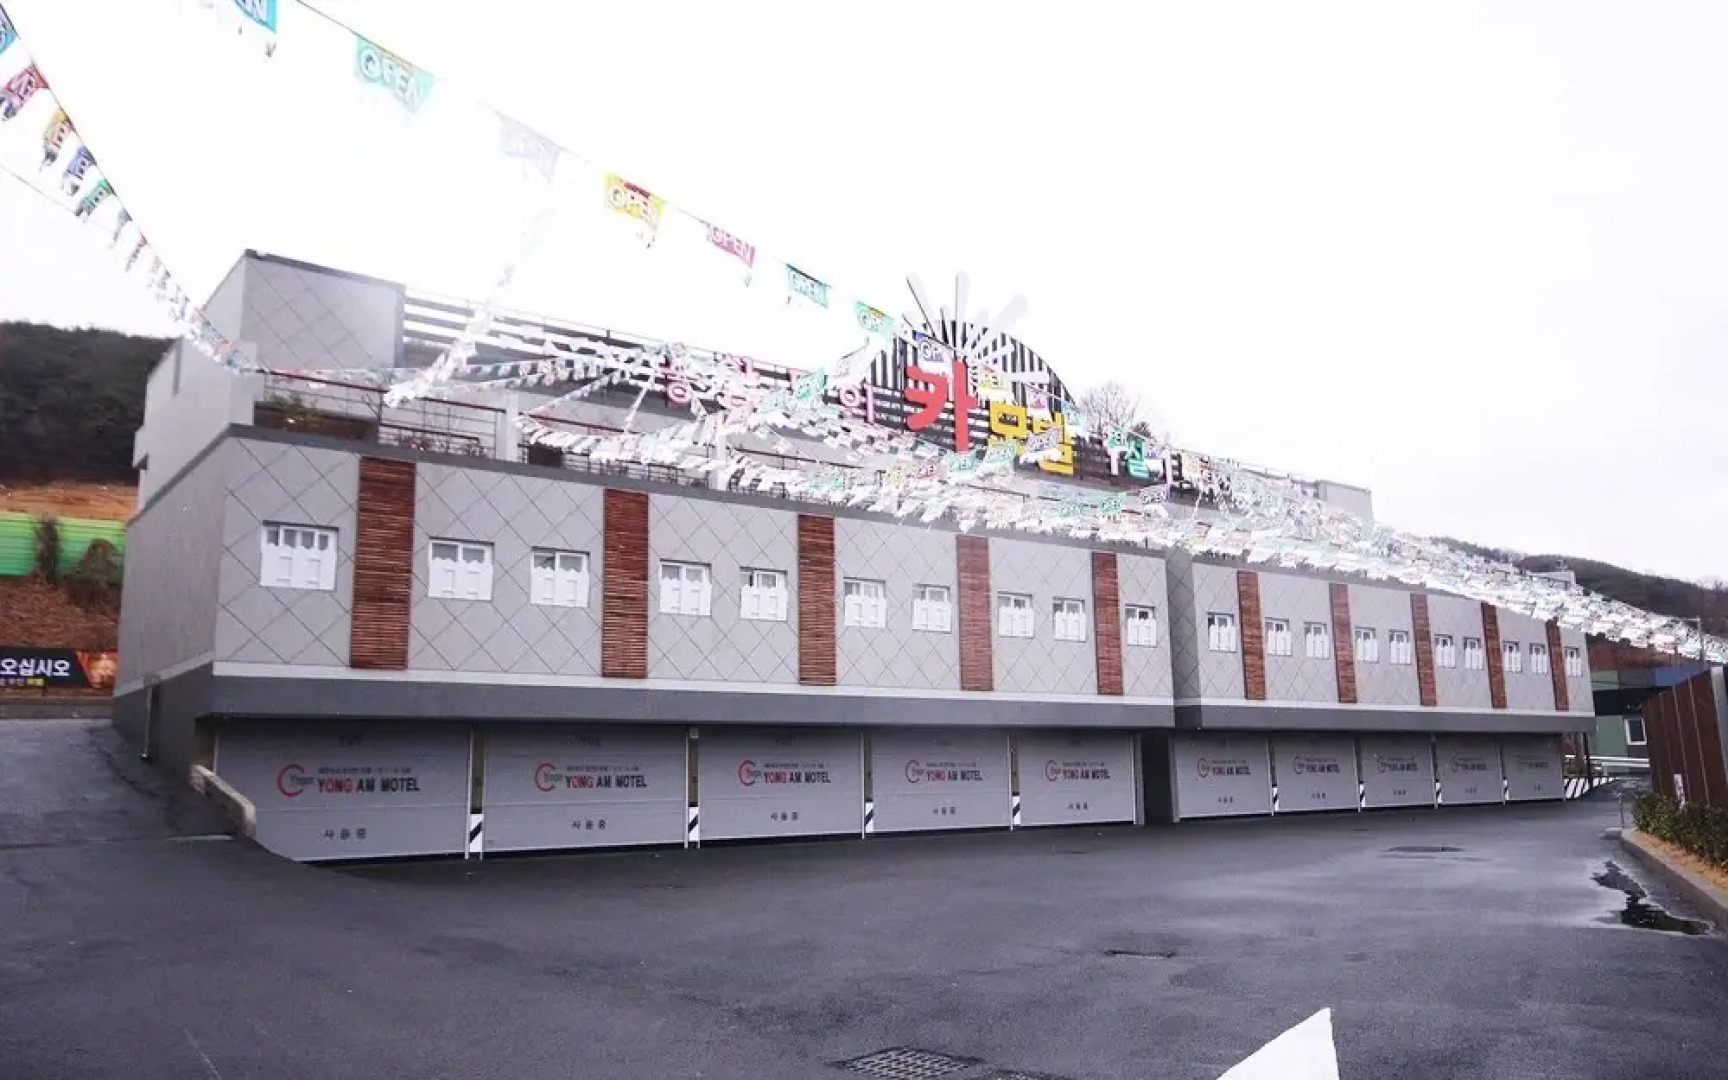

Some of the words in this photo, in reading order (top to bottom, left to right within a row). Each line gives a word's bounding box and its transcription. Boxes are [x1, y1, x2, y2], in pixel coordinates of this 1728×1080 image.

[358, 45, 423, 112] OPEN
[608, 184, 657, 226] OPEN
[709, 224, 753, 265] OPEN
[905, 359, 978, 454] 카
[0, 658, 70, 677] 오십시오
[318, 777, 355, 794] YONG
[356, 777, 376, 793] AM
[380, 777, 421, 792] MOTEL
[565, 775, 595, 789] YONG
[595, 775, 613, 789] AM
[615, 775, 648, 788] MOTEL
[763, 771, 787, 784] YONG
[789, 771, 803, 783] AM
[804, 771, 831, 783] MOTEL
